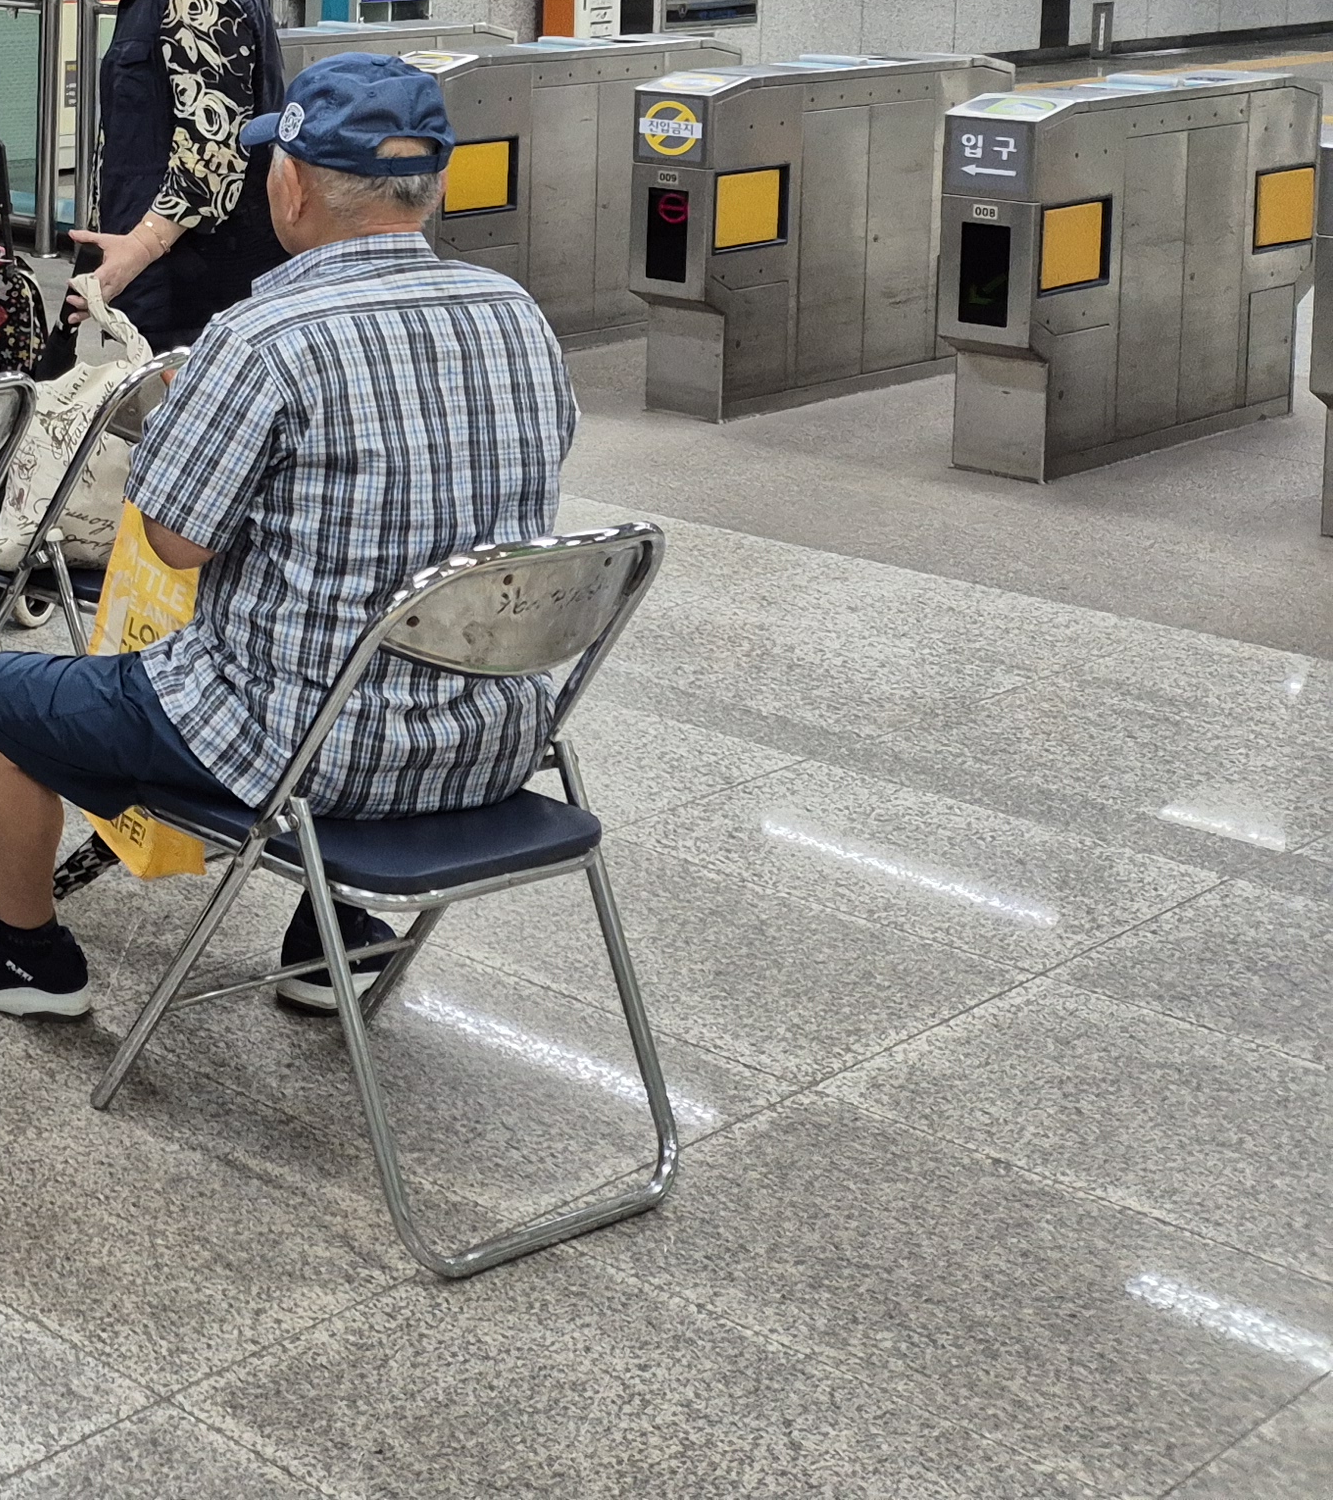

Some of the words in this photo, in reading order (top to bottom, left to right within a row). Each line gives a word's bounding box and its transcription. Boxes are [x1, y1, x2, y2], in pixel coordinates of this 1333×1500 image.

[648, 121, 694, 136] 진입금지
[961, 133, 1017, 160] 입구
[659, 173, 677, 182] 009
[975, 206, 996, 218] 008
